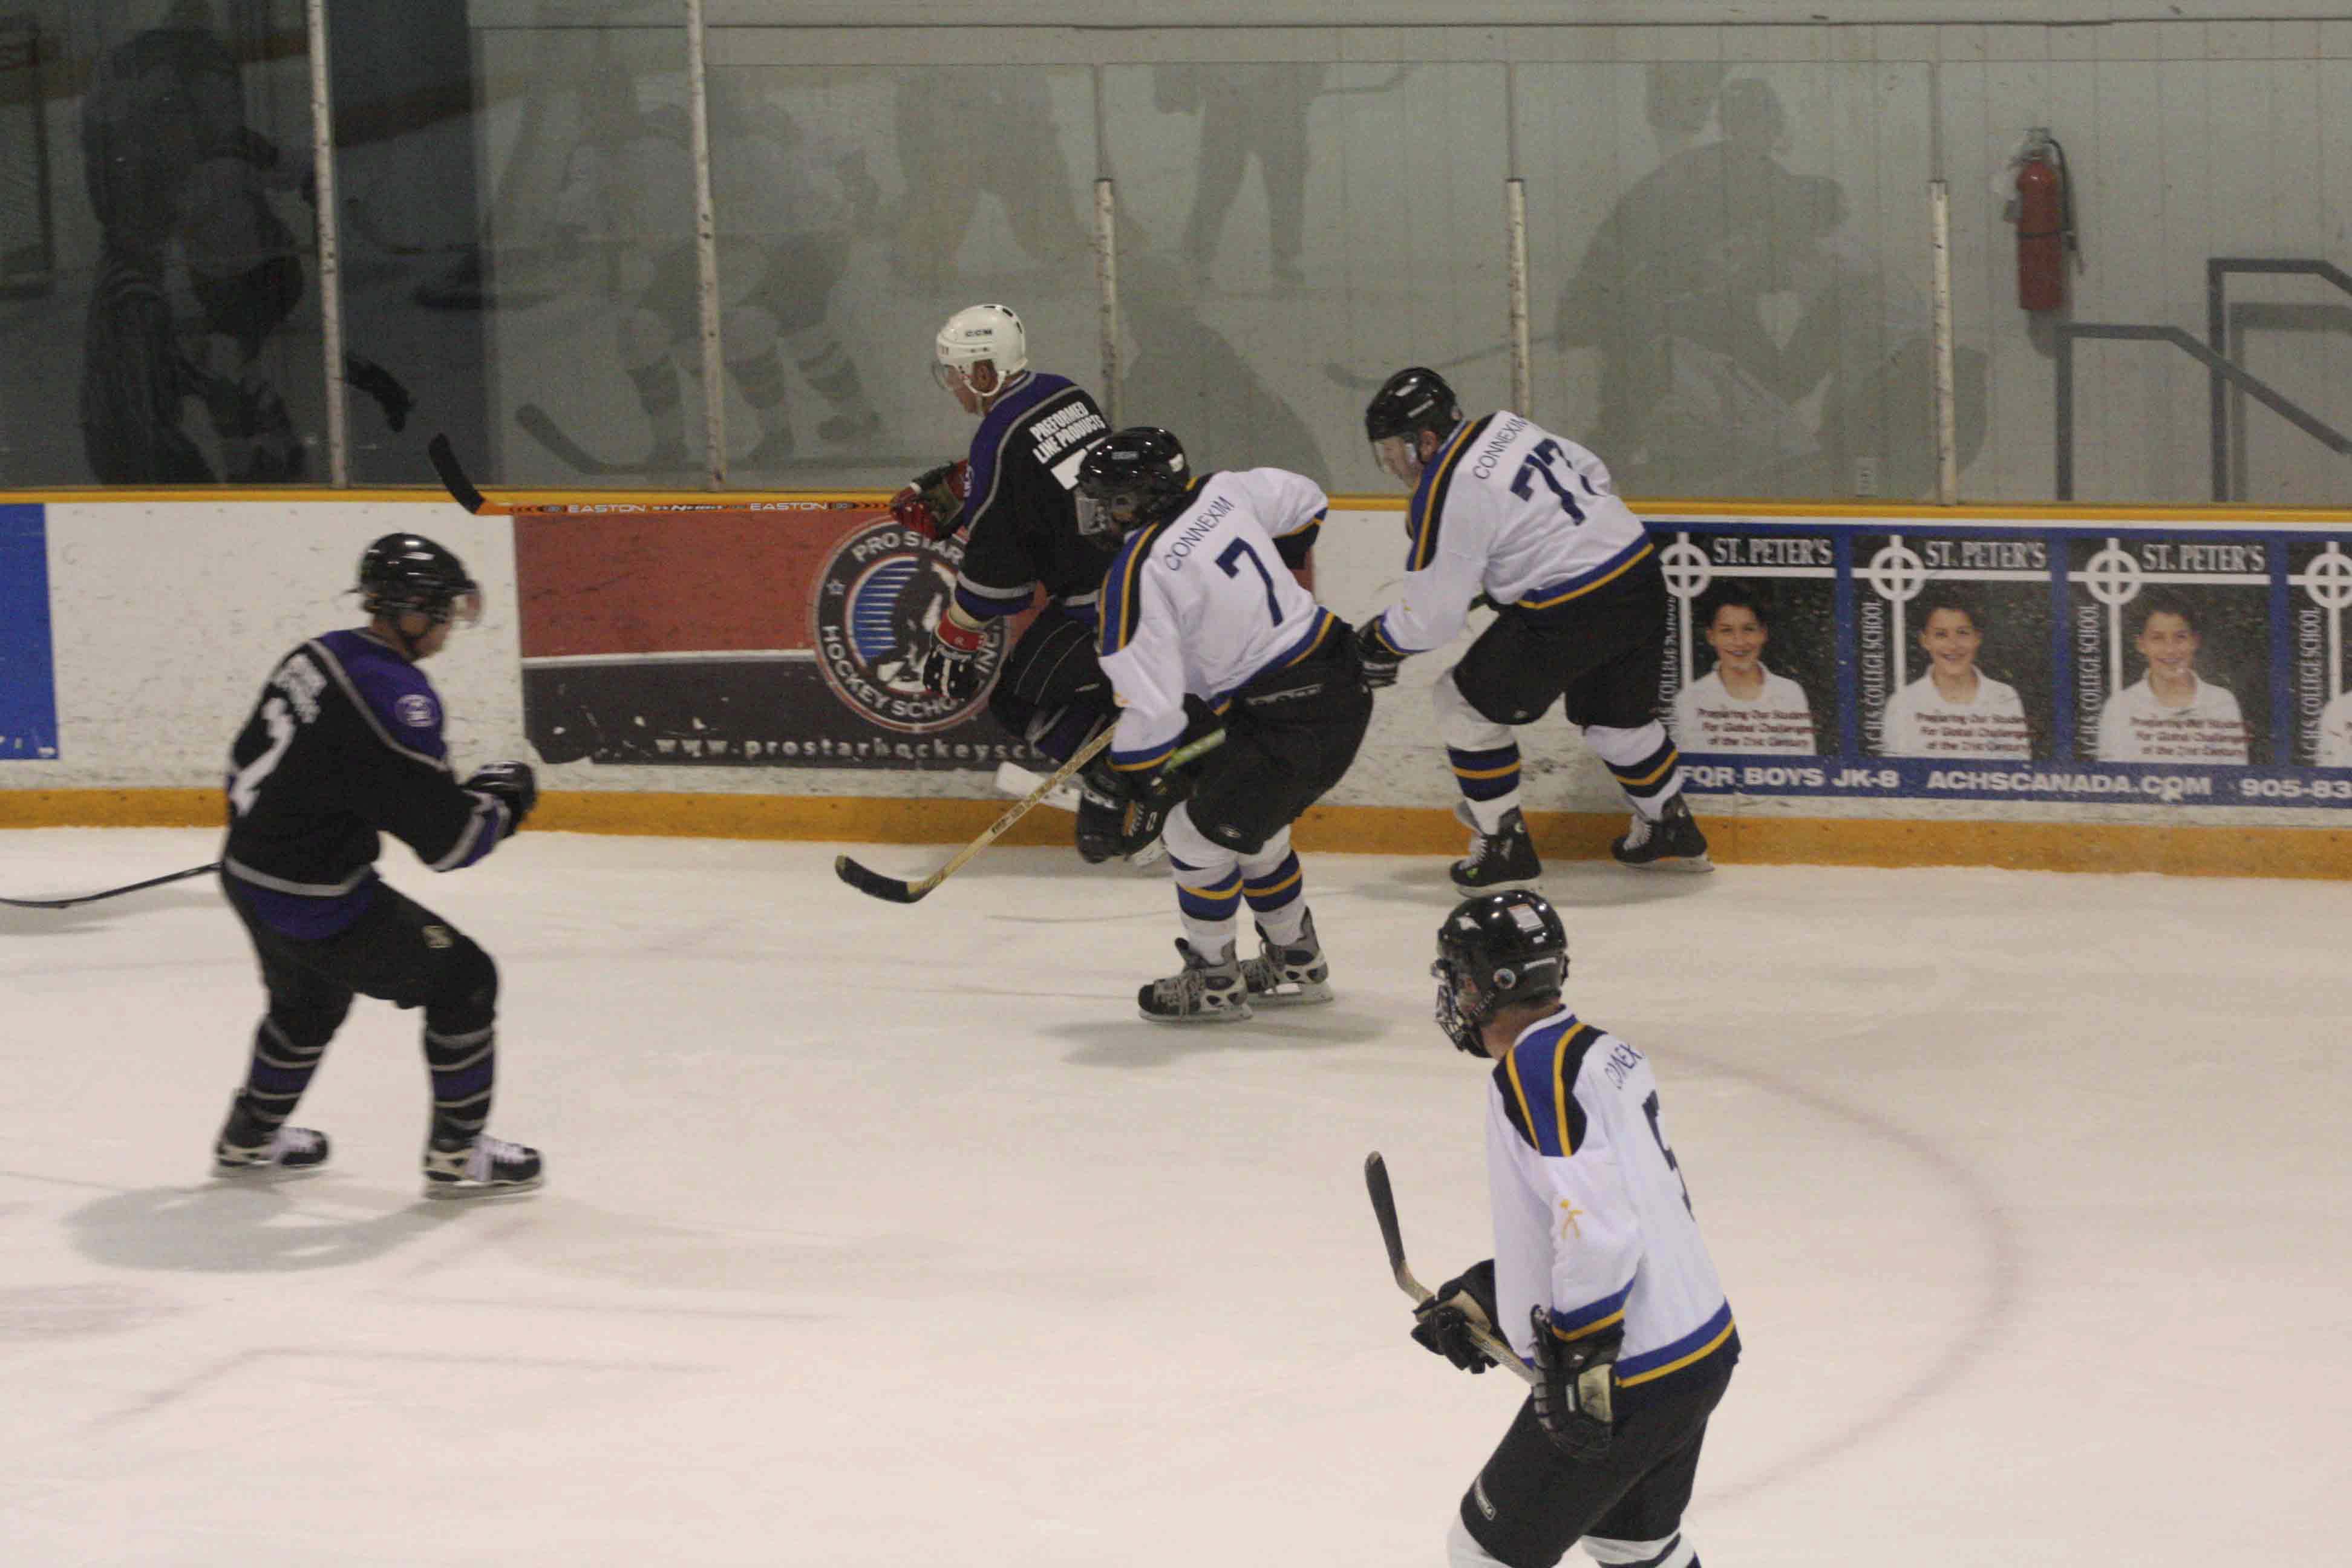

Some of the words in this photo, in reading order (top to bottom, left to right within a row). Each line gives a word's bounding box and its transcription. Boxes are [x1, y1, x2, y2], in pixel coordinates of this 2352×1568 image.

[1029, 401, 1089, 442] PREFORMED
[1032, 436, 1062, 464] LINE
[1055, 414, 1106, 448] PRODUCTS
[567, 503, 647, 514] EASTON
[750, 501, 829, 511] EASTON
[851, 532, 900, 563] PRO
[1165, 495, 1235, 572] CONNEXIM
[1713, 538, 1746, 564] ST.
[1748, 538, 1832, 564] PETER'S
[1961, 542, 2046, 568] PETER'S
[2143, 544, 2177, 570] ST.
[2180, 545, 2265, 572] PETER'S
[1214, 535, 1284, 628] 7
[1861, 601, 1884, 649] SCHOOL
[2077, 604, 2100, 654] SCHOOL
[2299, 607, 2322, 658] SCHOOL
[822, 625, 891, 710] HOCKEY
[891, 696, 965, 717] SCHO
[1863, 652, 1886, 707] COLLEGE
[2079, 656, 2102, 711] COLLEGE
[2300, 660, 2323, 716] COLLEGE
[1743, 767, 1825, 786] BOYS
[1832, 769, 1900, 788] JK-8
[1926, 770, 2213, 795] ACHSCANADA.COM
